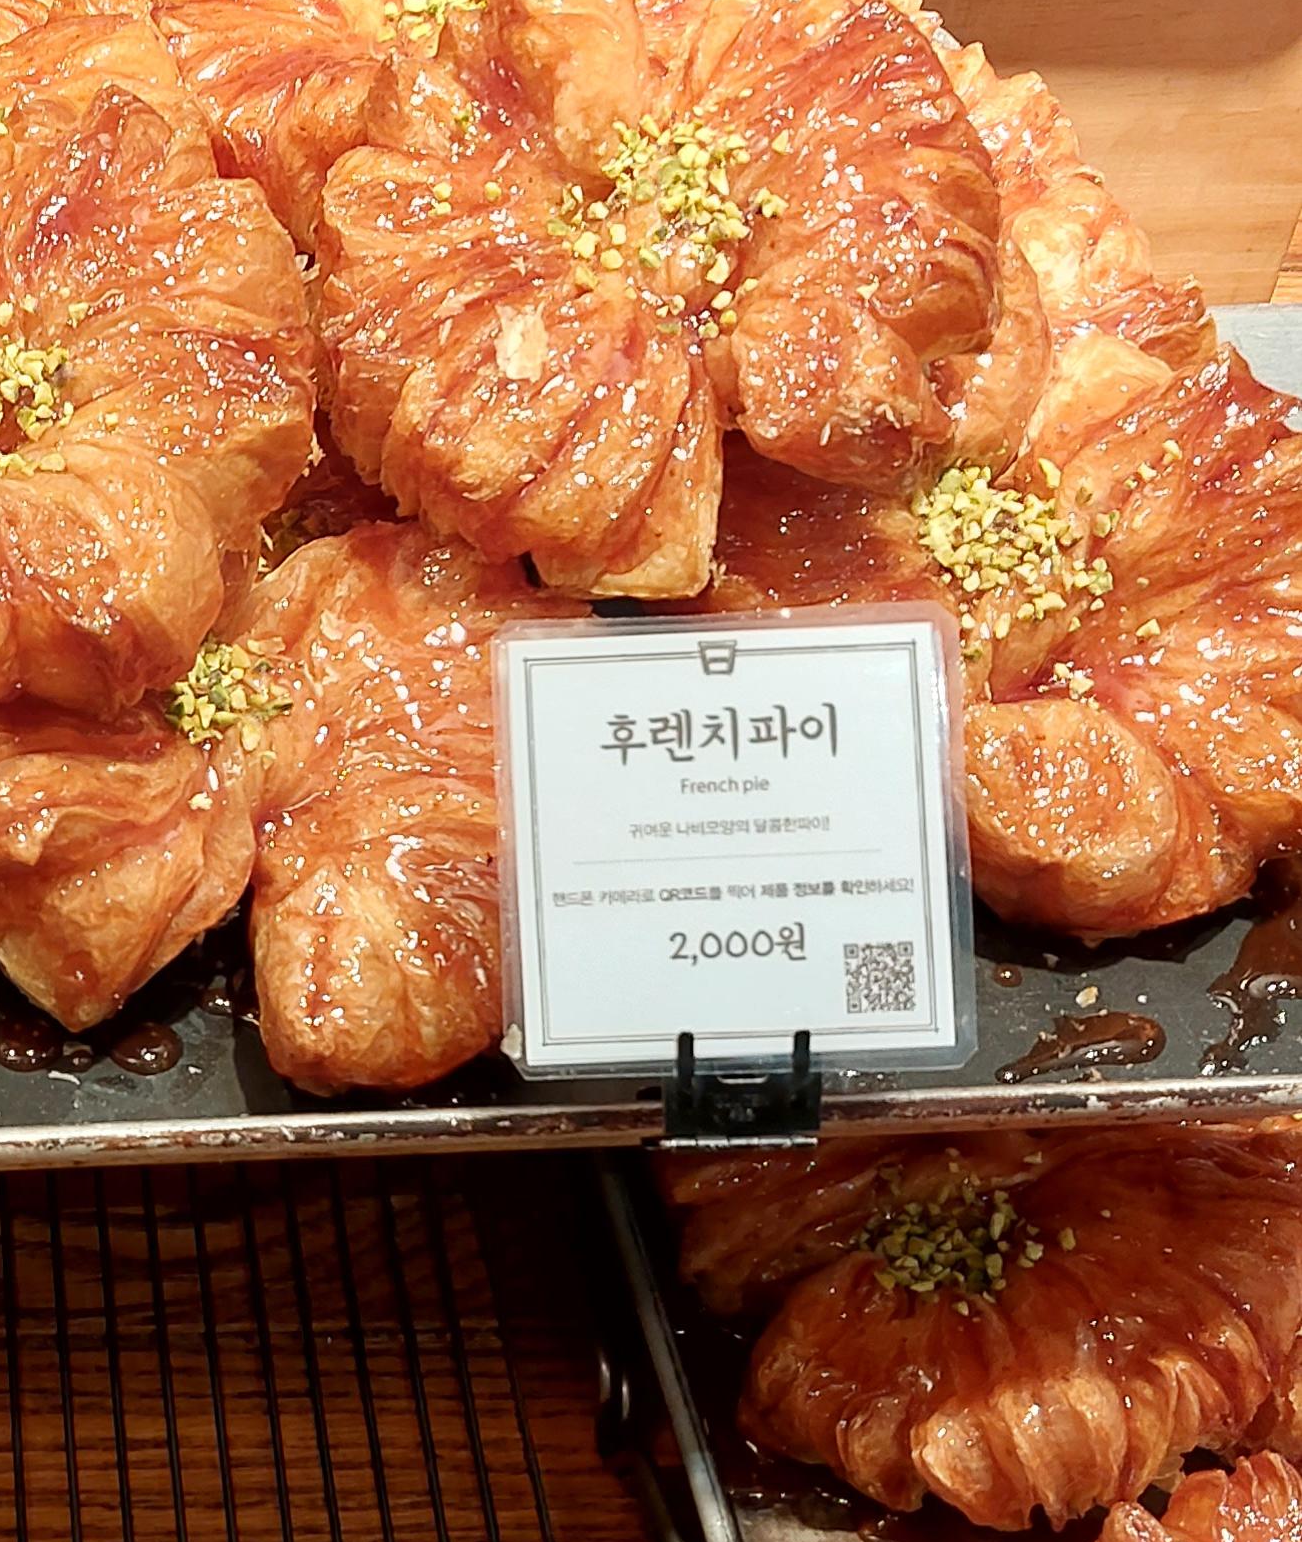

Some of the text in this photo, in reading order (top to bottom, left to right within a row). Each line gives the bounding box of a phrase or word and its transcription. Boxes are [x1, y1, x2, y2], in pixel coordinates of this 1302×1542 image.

[600, 702, 839, 766] 후렌치파이
[680, 776, 771, 795] French pie
[629, 821, 672, 839] 귀여운
[599, 889, 656, 906] 카메라로
[659, 886, 722, 902] QR코드를
[760, 882, 789, 899] 제품
[794, 880, 835, 898] 정보를
[841, 877, 915, 896] 확인하세요!
[669, 921, 807, 967] 2,000원
